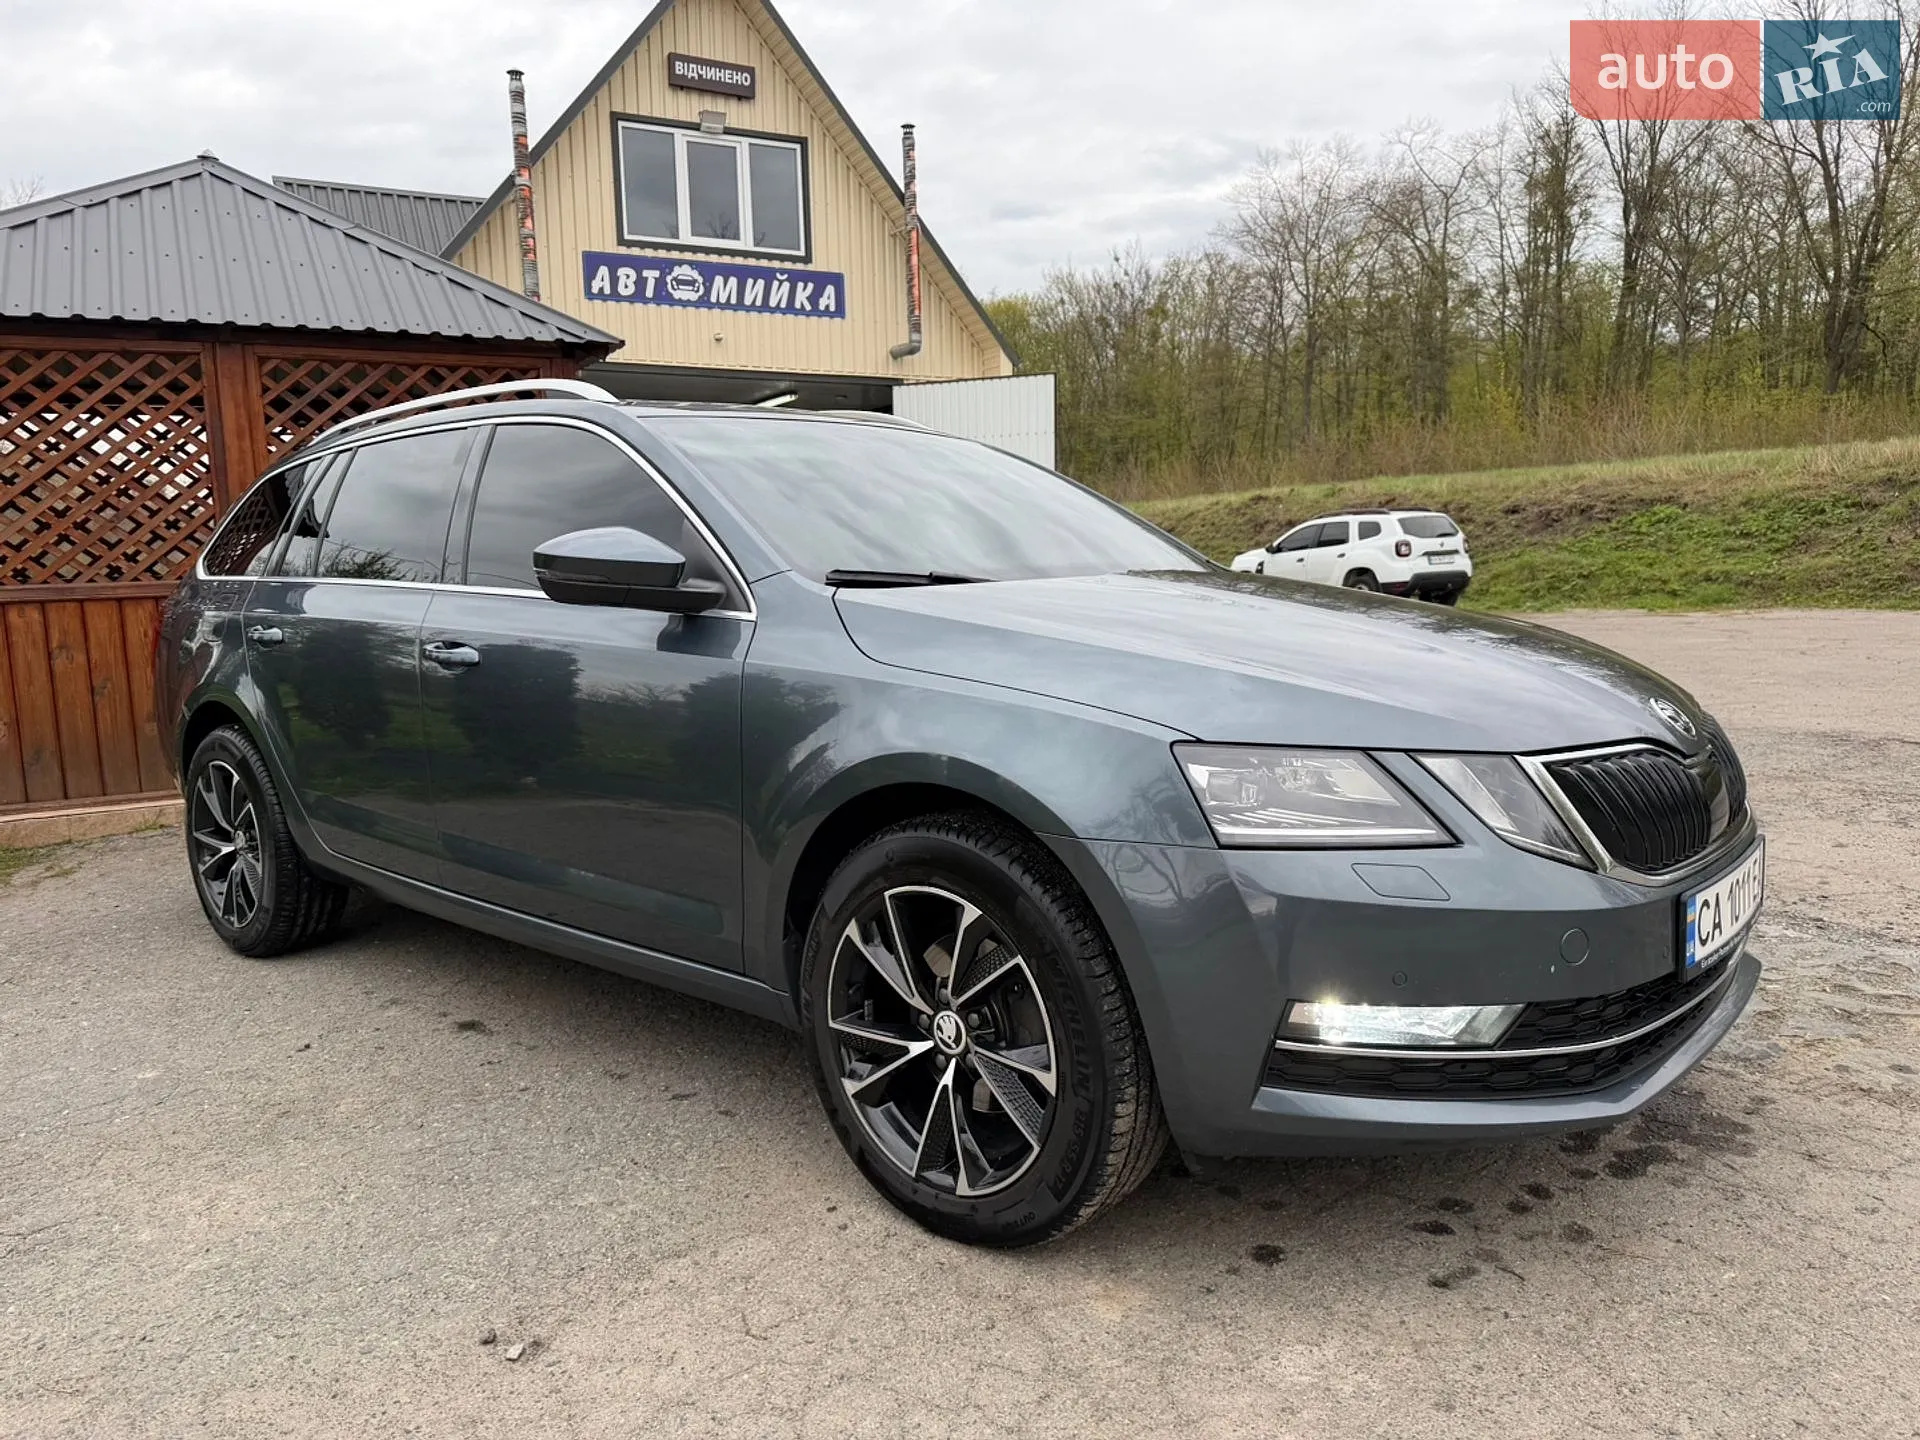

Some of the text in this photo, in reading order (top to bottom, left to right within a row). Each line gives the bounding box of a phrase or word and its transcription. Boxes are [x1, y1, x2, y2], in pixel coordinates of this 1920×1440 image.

[675, 61, 751, 87] ВІДЧИНЕНО
[1697, 892, 1723, 947] CA
[1047, 954, 1091, 1092] MICHELIN
